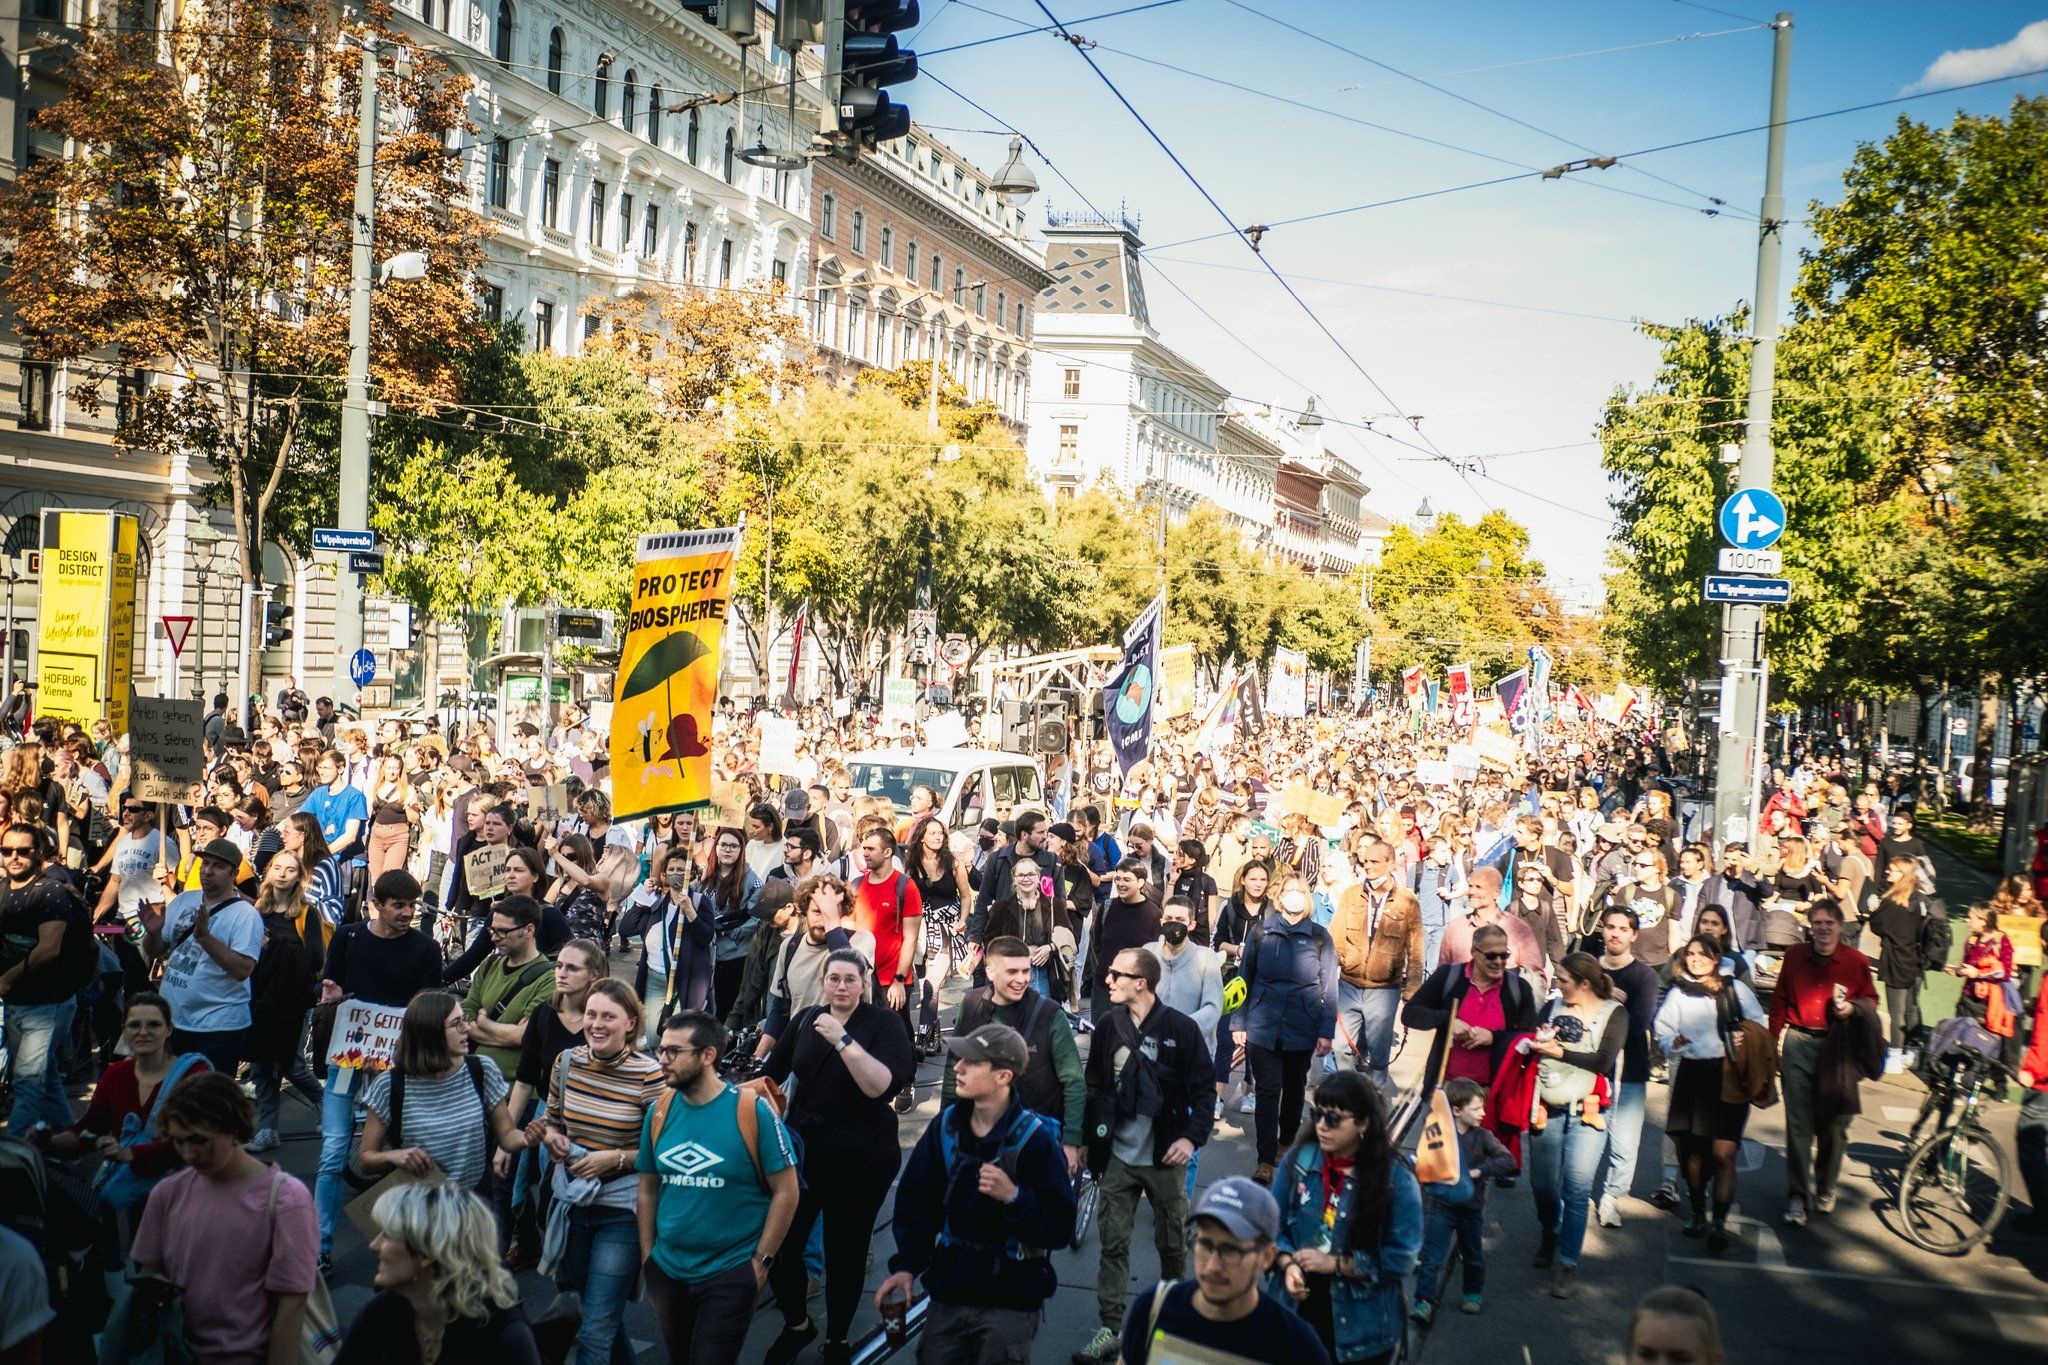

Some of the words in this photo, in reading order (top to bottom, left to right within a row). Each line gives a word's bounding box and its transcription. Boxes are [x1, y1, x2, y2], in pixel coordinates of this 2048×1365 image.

[843, 107, 852, 115] 11
[315, 534, 321, 543] 1.
[321, 534, 371, 546] Wipplingerstraße
[59, 549, 97, 562] DESIGN
[1729, 552, 1772, 569] 100m
[58, 563, 104, 577] DISTRICT
[638, 567, 724, 600] PROTECT
[629, 598, 726, 633] BIOSPHERE
[44, 672, 87, 686] HOFBURG
[43, 685, 73, 698] Vienna
[130, 700, 158, 719] Arten
[163, 704, 195, 726] gehen,
[130, 726, 158, 745] Autos
[164, 732, 197, 750] stehen,
[164, 753, 188, 766] wehen
[153, 773, 171, 782] noch
[173, 775, 188, 784] eine
[145, 784, 170, 800] Zukunft
[471, 851, 492, 866] ACT
[350, 1008, 371, 1026] IT'S
[374, 1036, 388, 1048] IN
